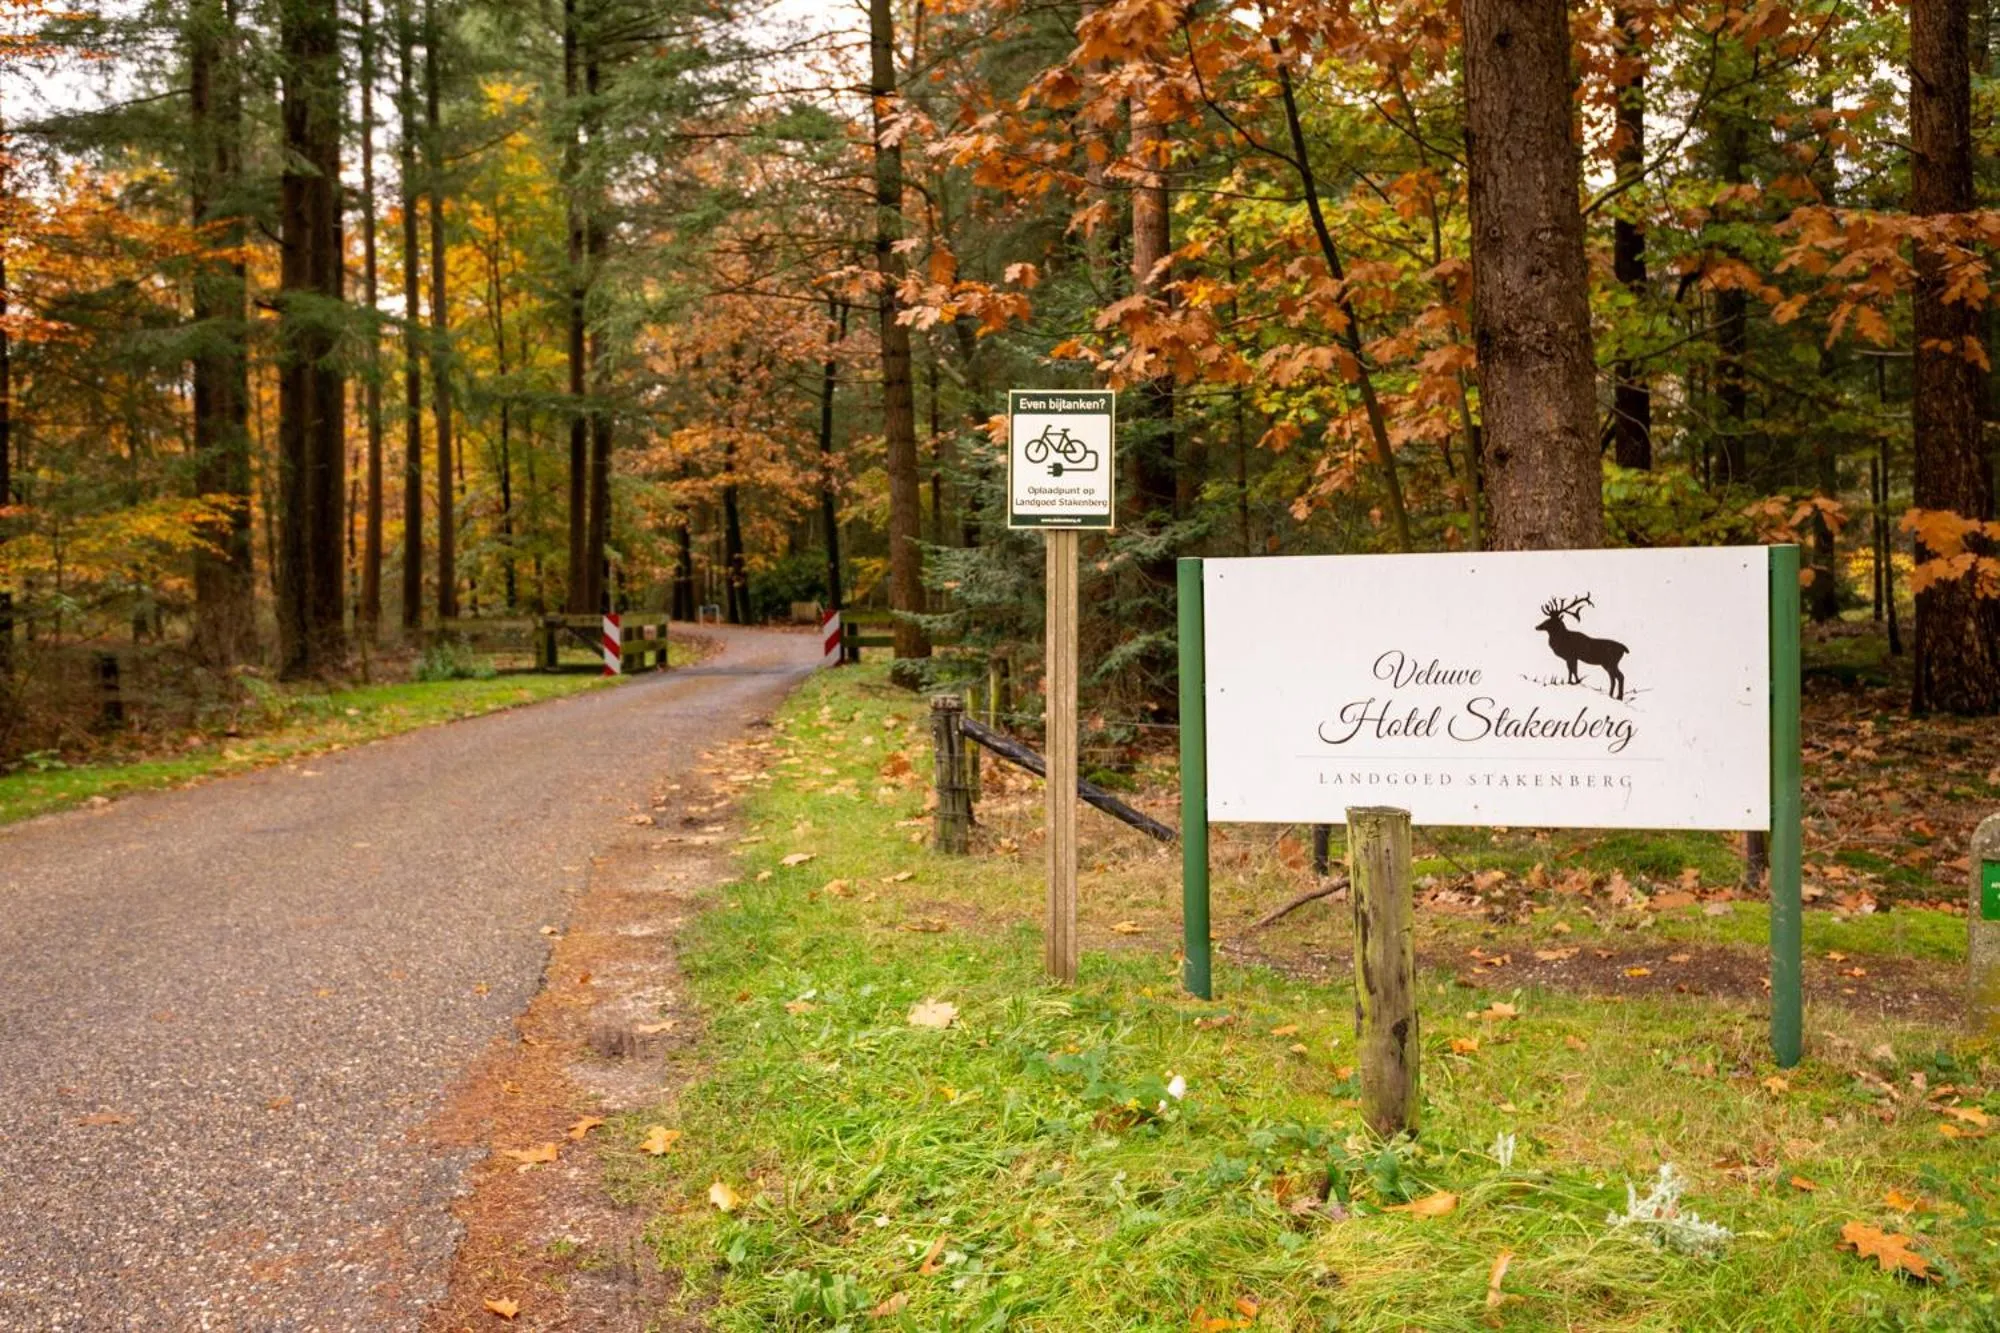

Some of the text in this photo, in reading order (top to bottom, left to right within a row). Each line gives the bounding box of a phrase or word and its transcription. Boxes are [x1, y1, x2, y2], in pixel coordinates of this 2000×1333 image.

[1019, 398, 1106, 412] Even bijtanken?
[1027, 486, 1095, 495] Oplaadpunt op
[1015, 497, 1108, 507] Landgoed Stakenberg
[1373, 650, 1483, 689] Veluwe
[1318, 696, 1637, 754] Hotel Stakenberg
[1318, 772, 1634, 789] LANDGOED STAKENBERG
